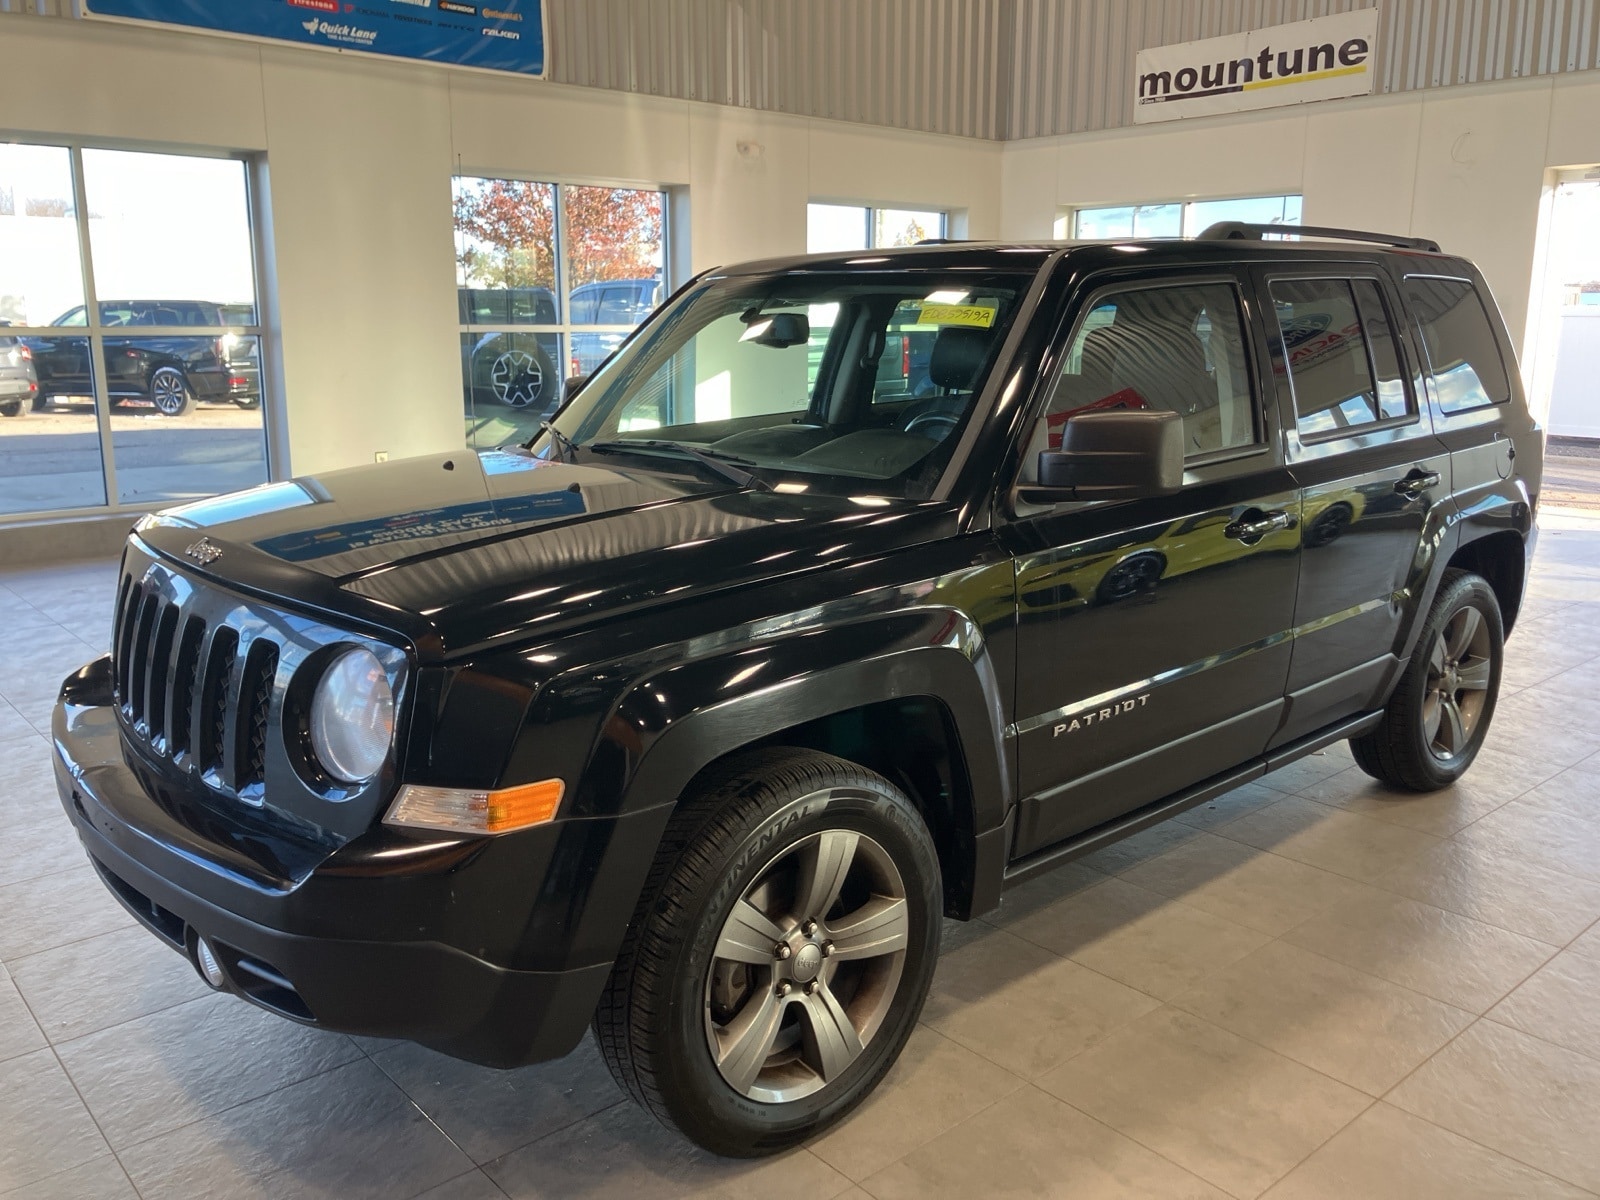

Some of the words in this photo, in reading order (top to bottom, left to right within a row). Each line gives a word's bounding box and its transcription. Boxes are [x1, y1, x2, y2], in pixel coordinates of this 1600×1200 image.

[319, 21, 350, 35] Quick
[350, 26, 378, 40] Lane
[482, 28, 520, 40] FALKEN
[1139, 38, 1369, 97] mountune
[1053, 694, 1151, 738] PATRIOT
